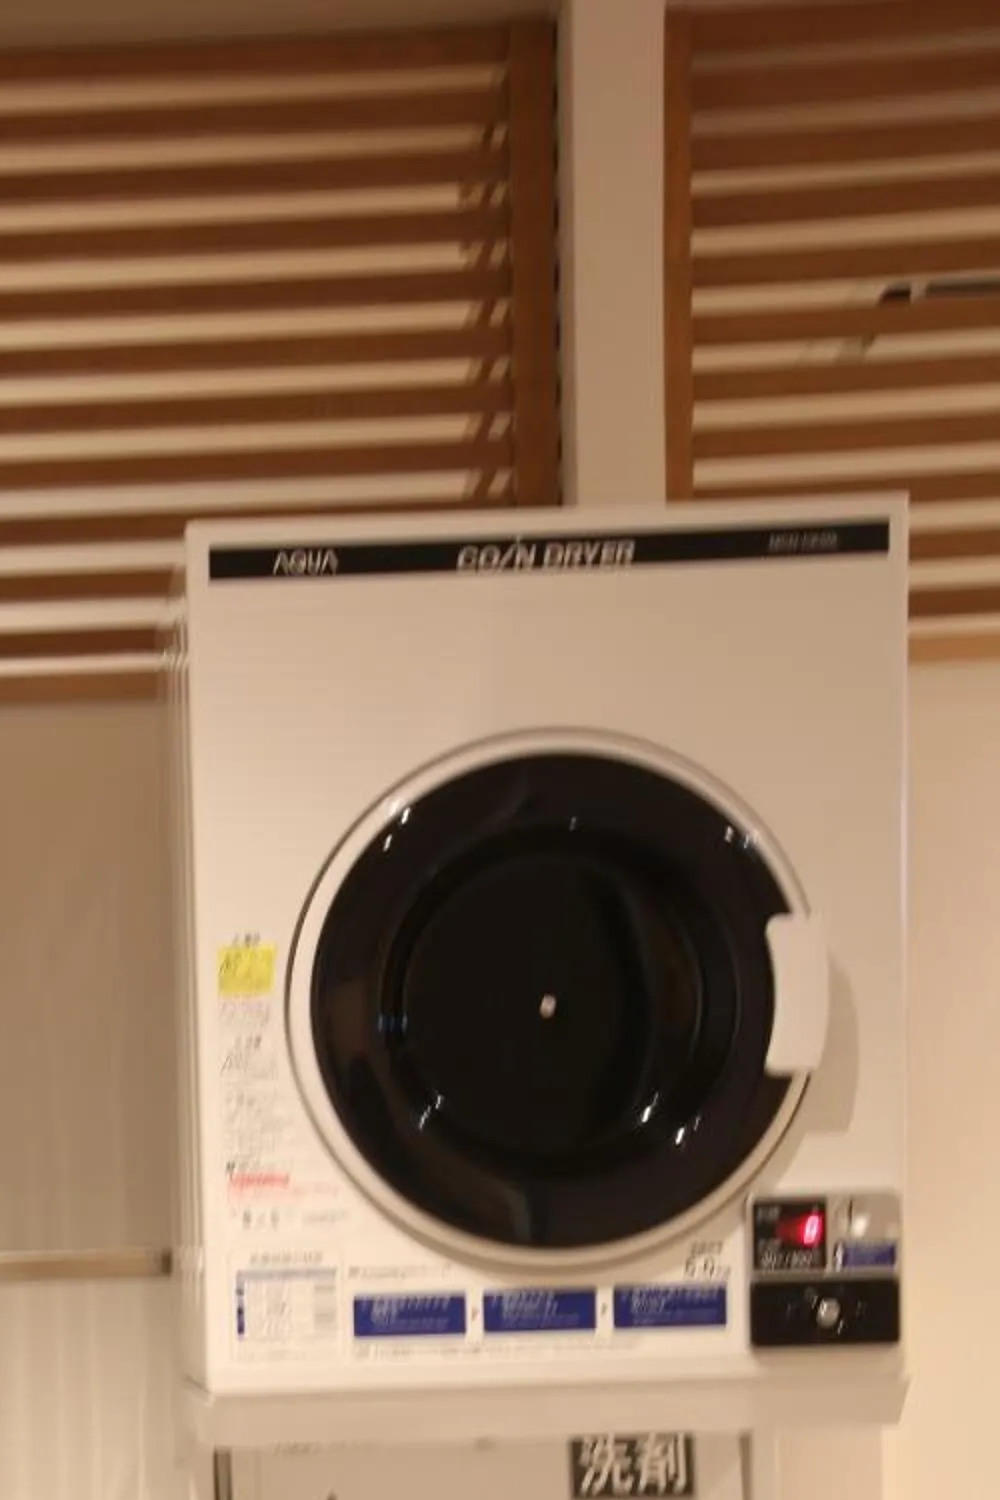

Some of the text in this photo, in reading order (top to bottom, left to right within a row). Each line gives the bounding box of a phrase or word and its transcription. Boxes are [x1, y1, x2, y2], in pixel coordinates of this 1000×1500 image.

[273, 549, 338, 577] AQUA
[543, 538, 635, 568] DRYER
[579, 1433, 688, 1496] 洗剤
